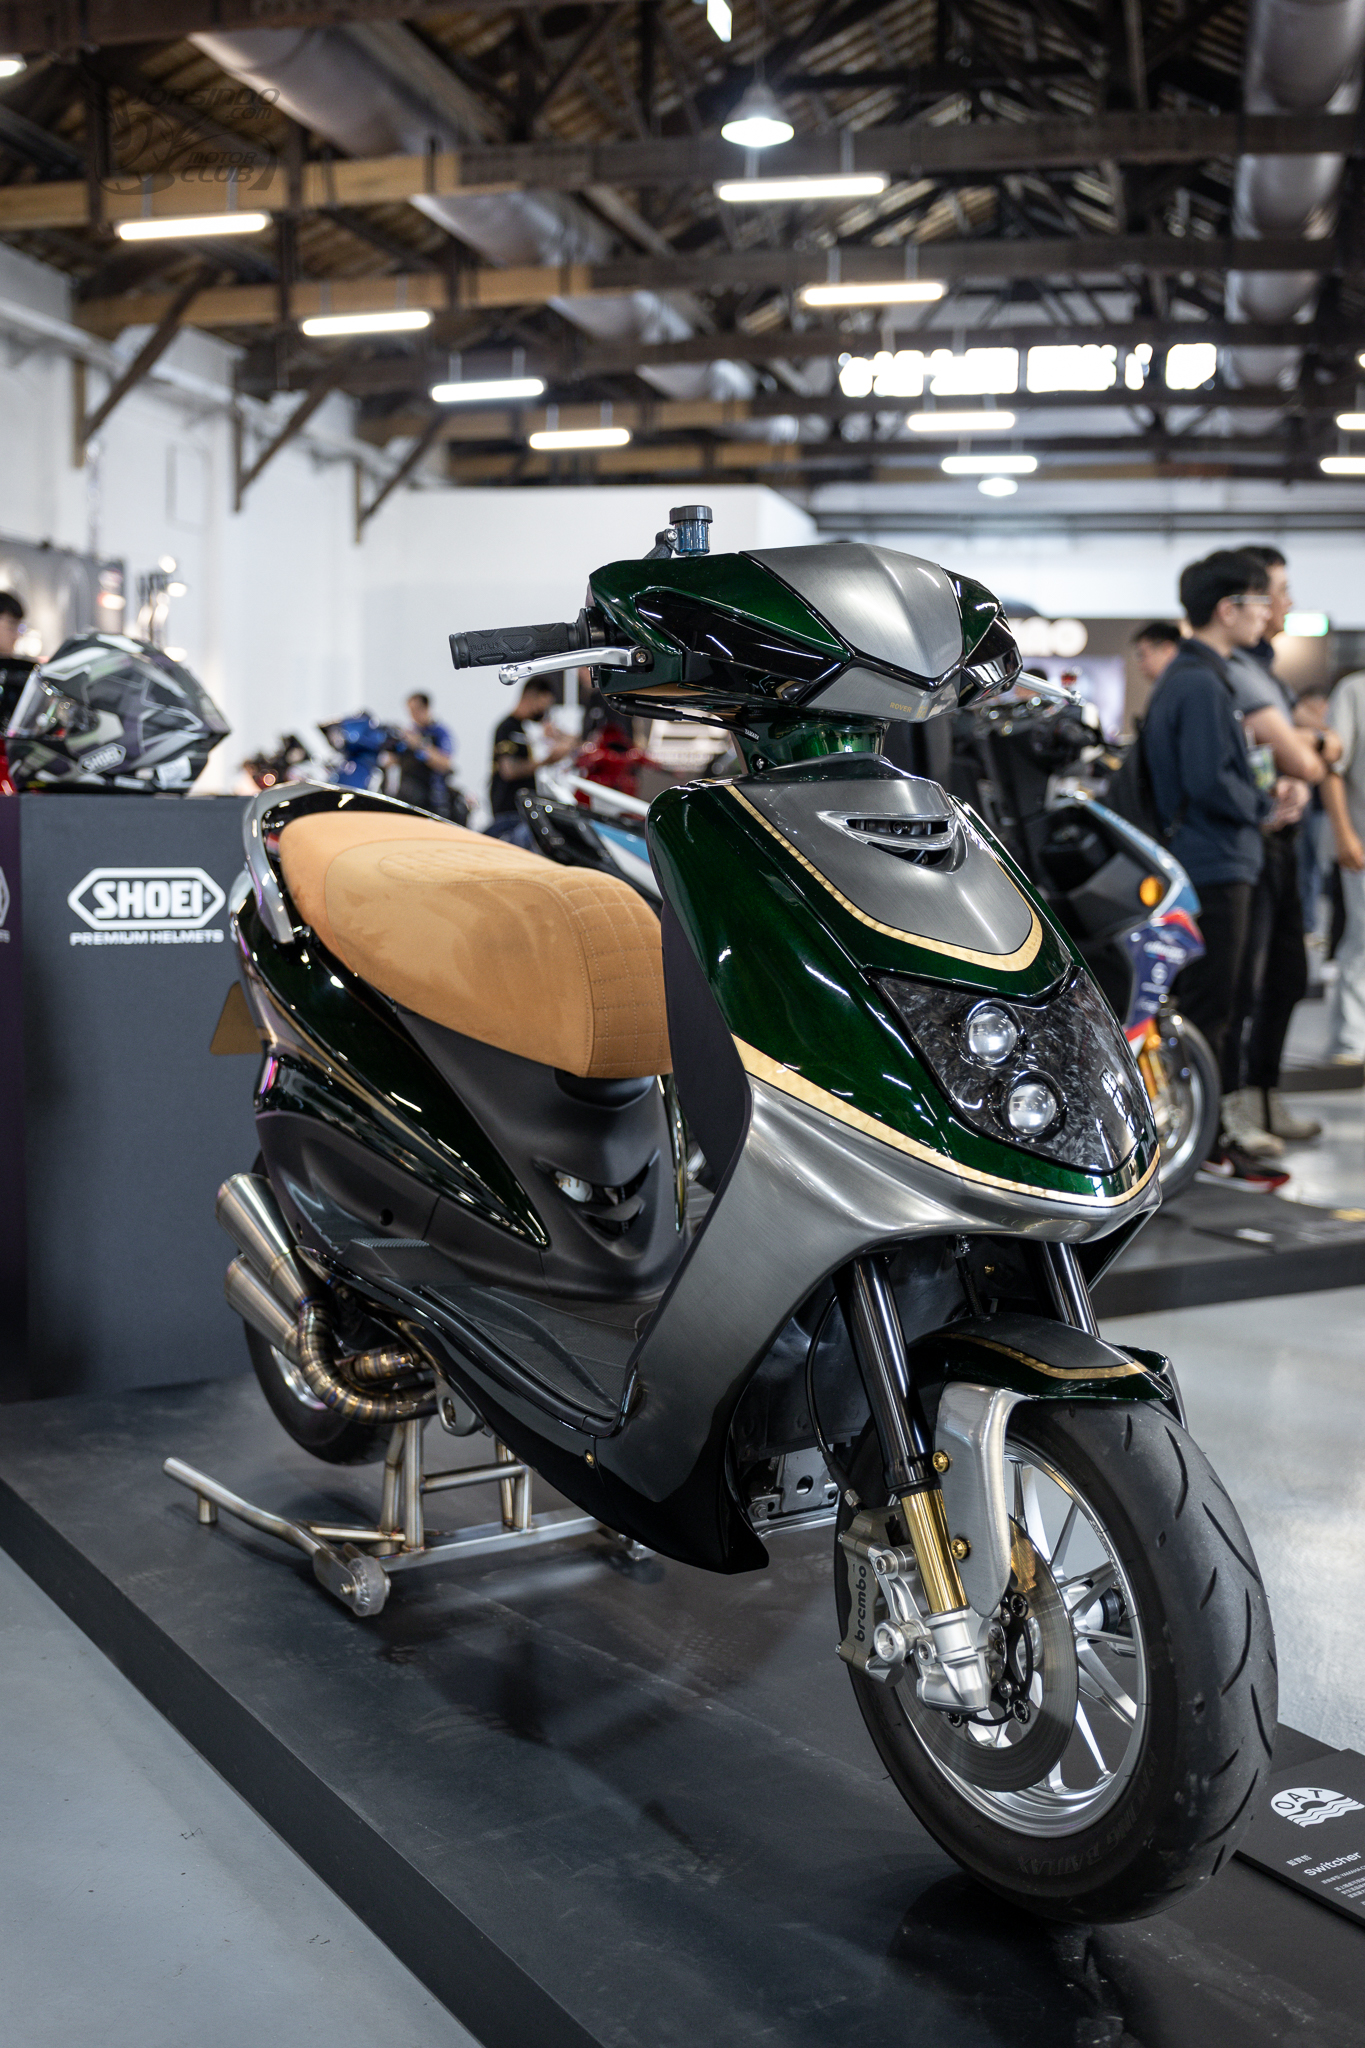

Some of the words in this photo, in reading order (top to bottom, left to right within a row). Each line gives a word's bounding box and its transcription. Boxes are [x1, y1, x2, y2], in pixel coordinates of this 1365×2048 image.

[889, 702, 913, 713] ROVER
[92, 880, 203, 919] SHOEI
[69, 931, 149, 946] PREMIUM
[150, 929, 225, 944] HELMETS
[854, 1565, 867, 1642] brembo
[1303, 1851, 1362, 1876] Switcher
